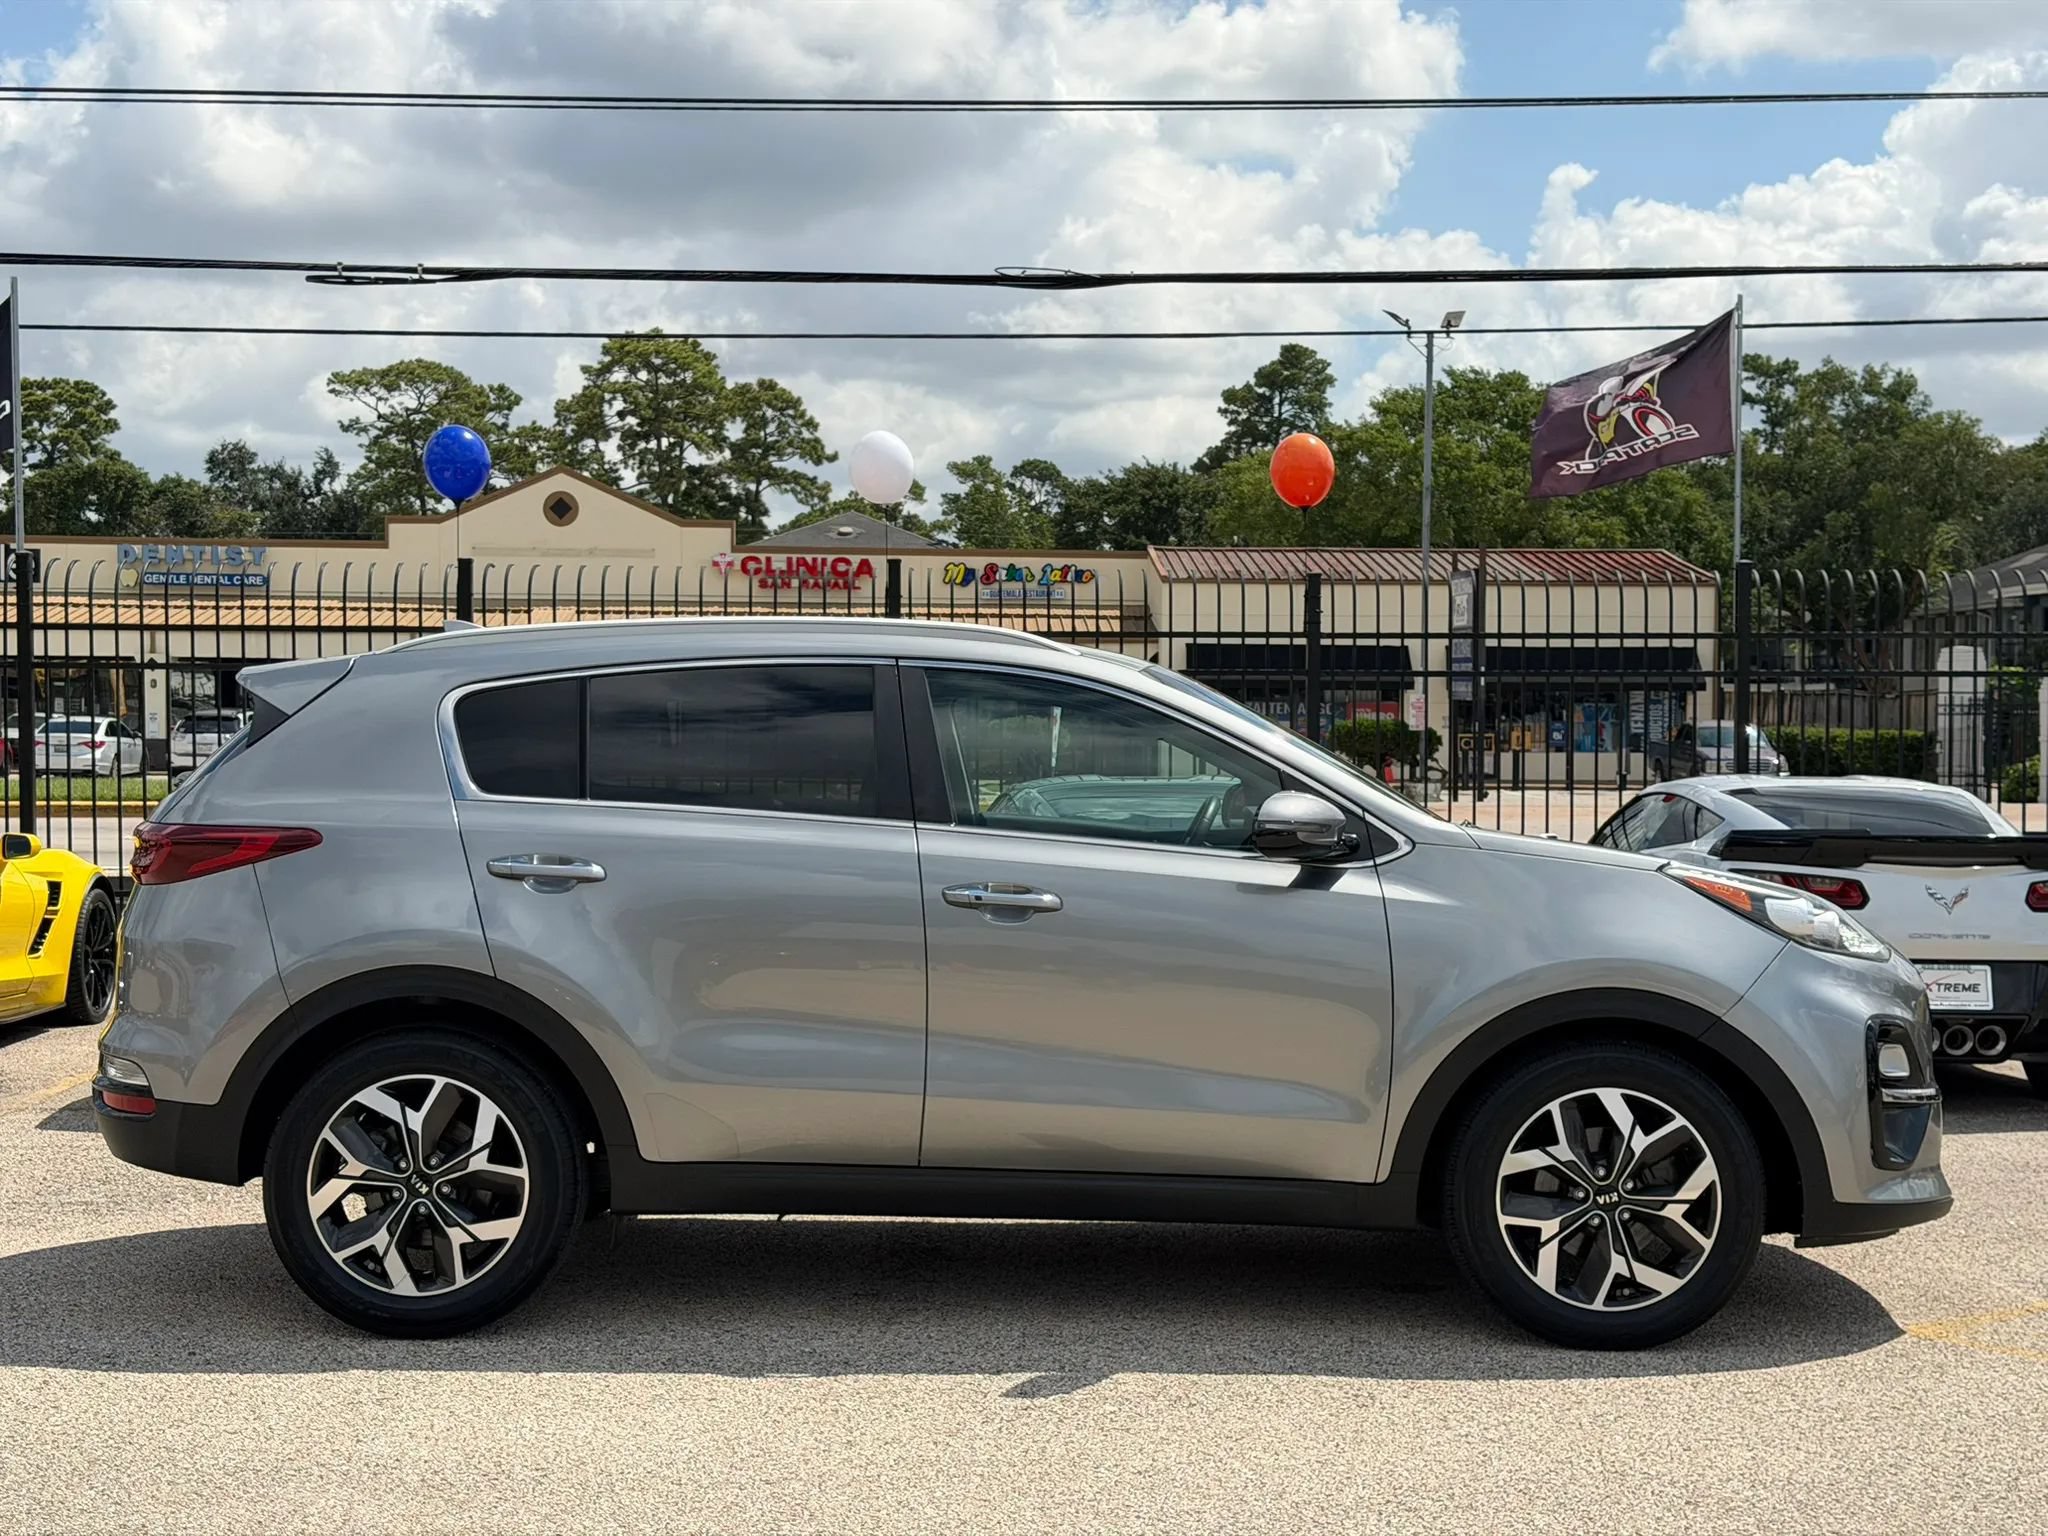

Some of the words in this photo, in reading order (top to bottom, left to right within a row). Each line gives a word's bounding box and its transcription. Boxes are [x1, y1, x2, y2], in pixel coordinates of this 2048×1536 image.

[117, 543, 267, 567] DENTIST
[740, 555, 874, 579] CLINICA
[943, 562, 977, 588] My
[980, 562, 1036, 586] Sabor
[1037, 563, 1096, 586] Latino
[144, 574, 187, 585] GENTLE
[411, 1174, 429, 1195] KIA
[1596, 1192, 1619, 1205] KIA
